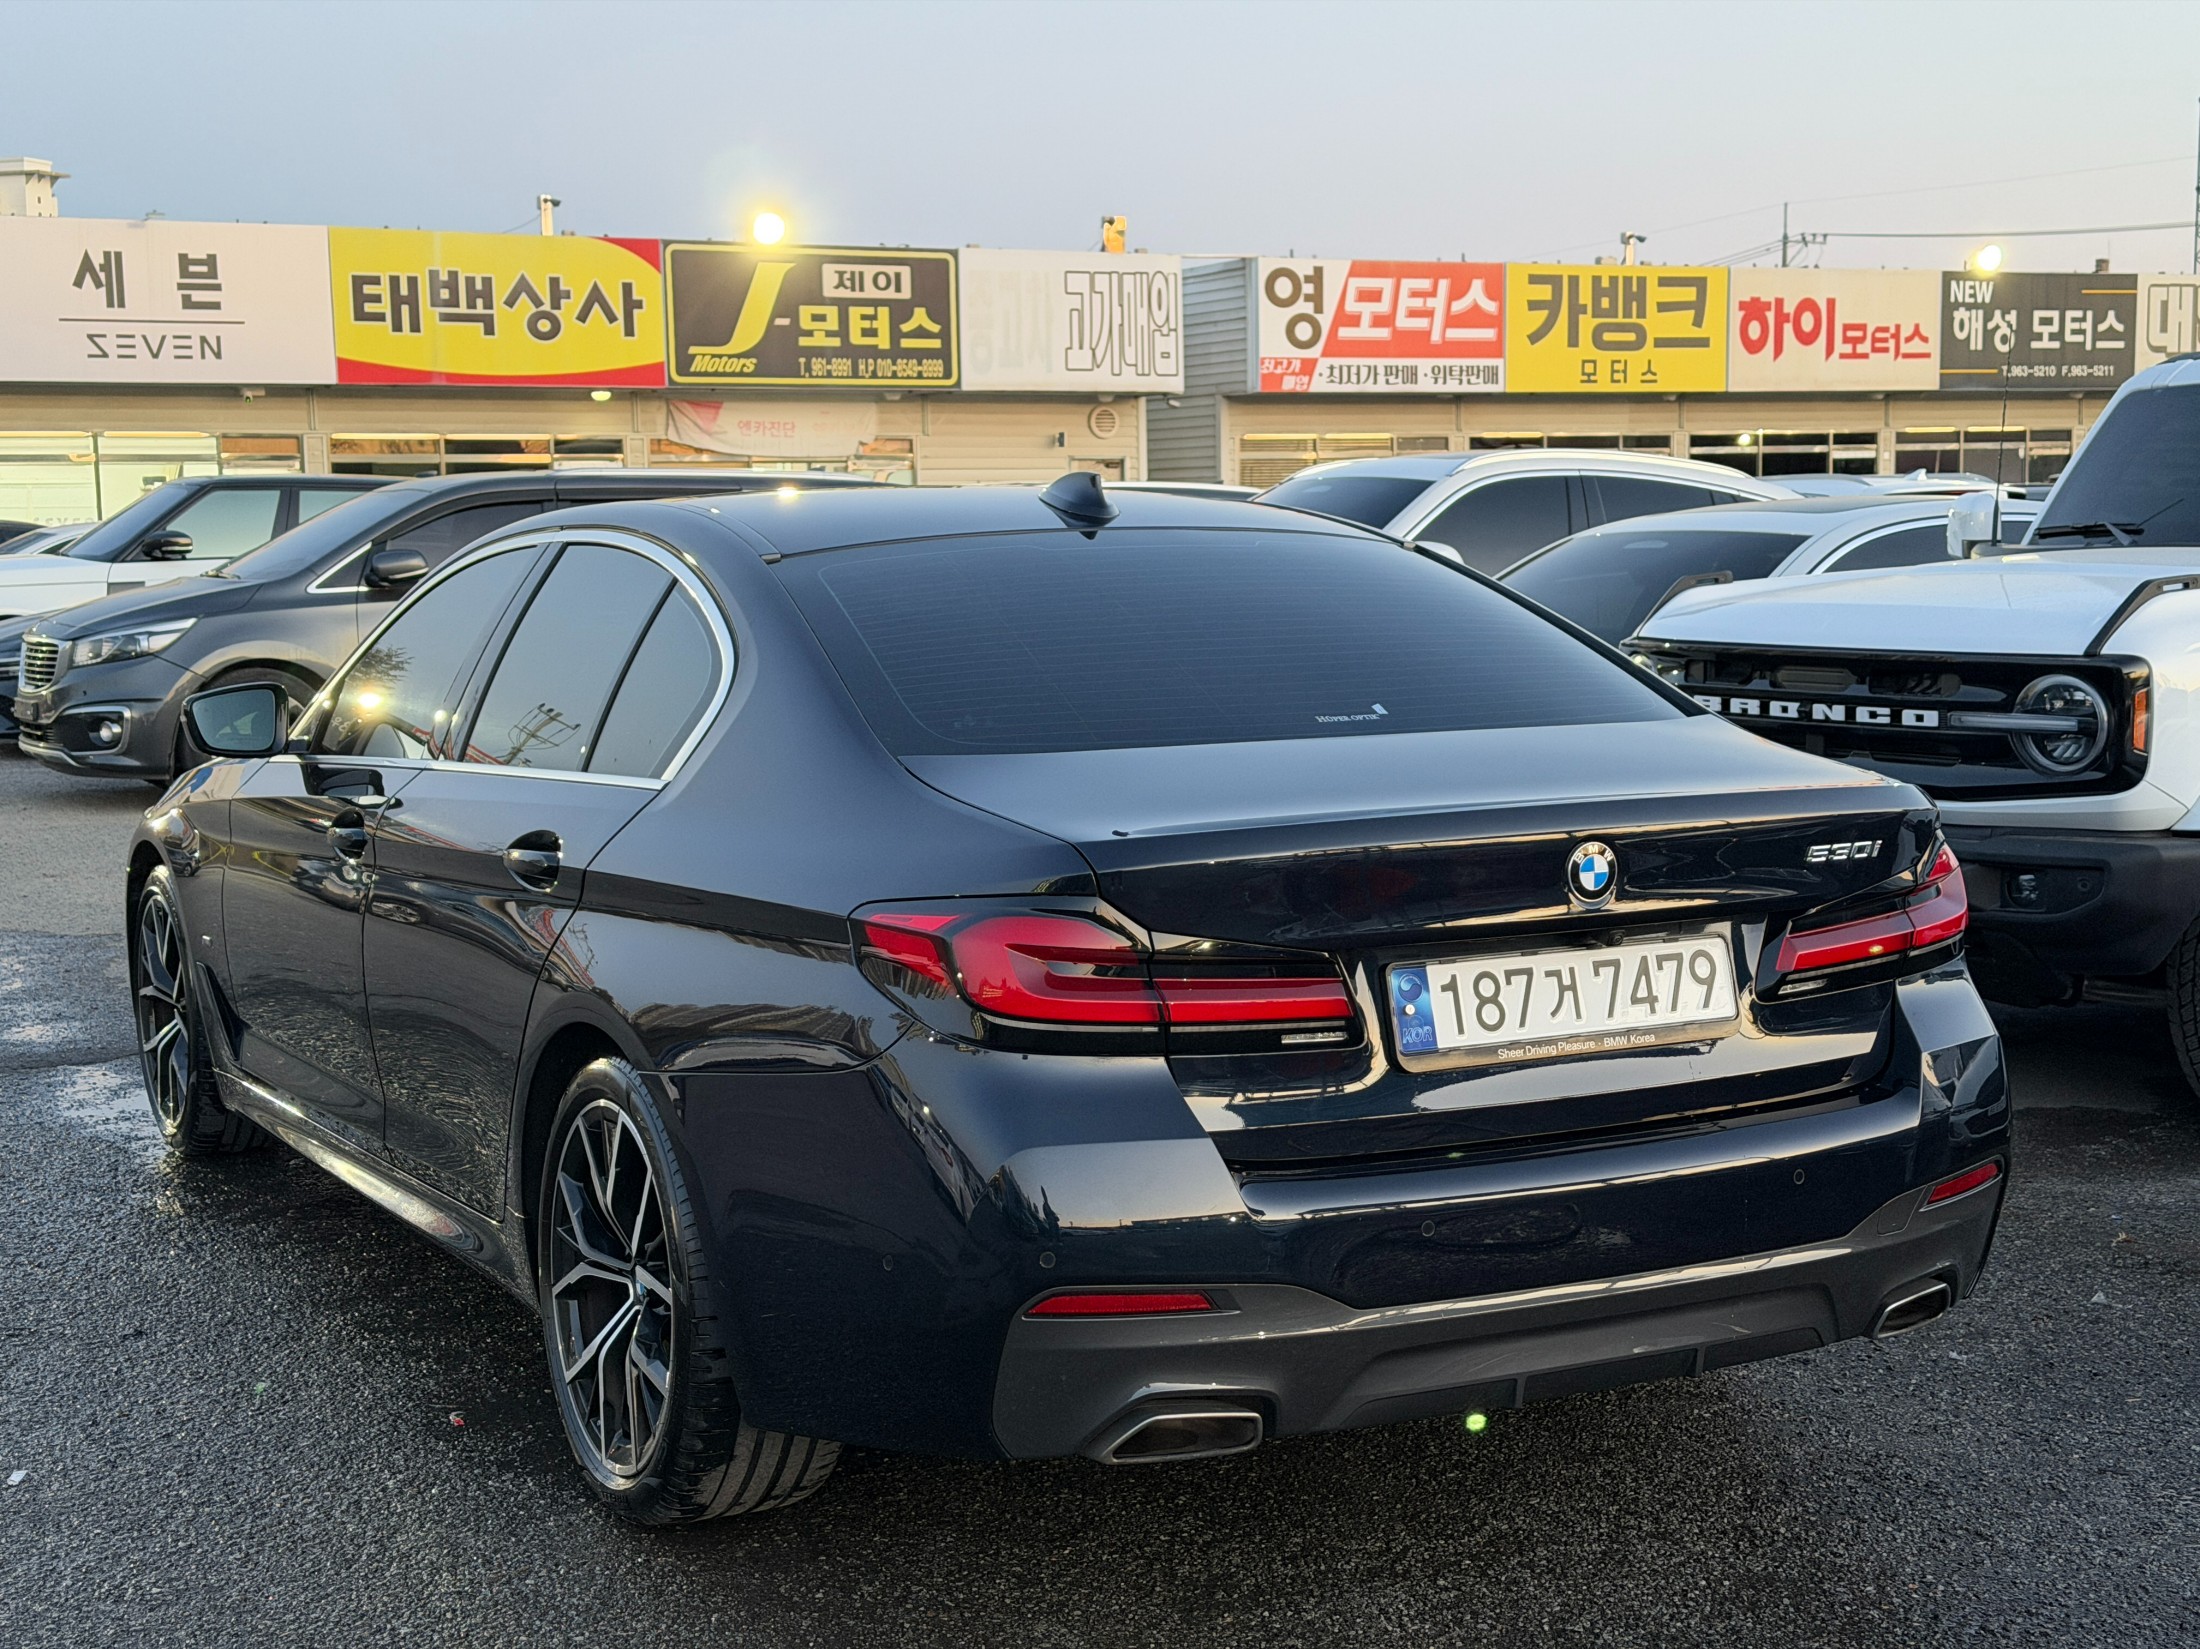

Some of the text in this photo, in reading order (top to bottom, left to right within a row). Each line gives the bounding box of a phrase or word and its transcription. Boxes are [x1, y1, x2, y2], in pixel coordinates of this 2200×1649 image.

[832, 270, 902, 294] 제이
[1950, 280, 1994, 304] NEW
[350, 268, 645, 342] 태백상사
[1337, 276, 1500, 345] 모터스
[1526, 273, 1711, 352] 카뱅크
[798, 305, 942, 350] 모터스
[1064, 270, 1179, 377] 고가매입
[1952, 306, 2126, 353] 해성 모터스
[2147, 283, 2200, 357] 대
[86, 332, 224, 361] SEVEN
[689, 354, 758, 373] Motors
[1579, 359, 1659, 385] 모터스
[737, 419, 796, 438] 엔카진단
[1693, 694, 1939, 728] BRONCO
[1573, 844, 1614, 864] BMW
[1804, 840, 1883, 862] 530i
[1402, 1025, 1433, 1044] KOR
[1498, 1033, 1656, 1059] Sheer Driving Pleasure BMW Korea
